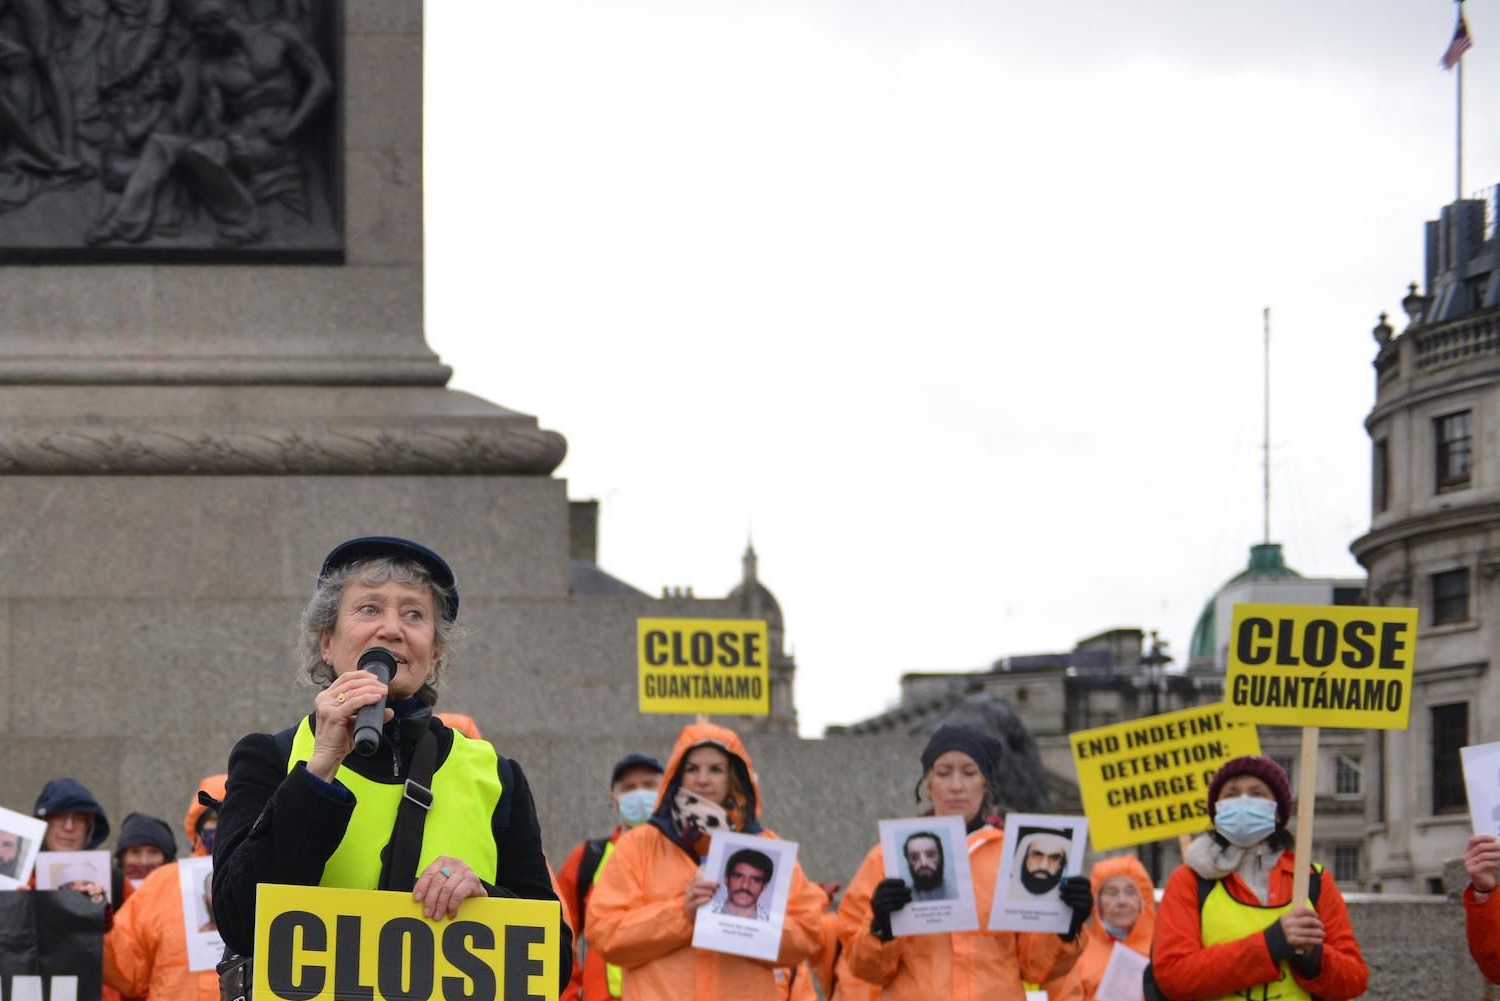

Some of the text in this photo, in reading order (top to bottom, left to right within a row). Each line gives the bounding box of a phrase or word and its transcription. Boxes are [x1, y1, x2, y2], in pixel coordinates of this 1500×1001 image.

[644, 630, 761, 668] CLOSE
[1237, 617, 1408, 669] CLOSE
[644, 669, 762, 700] GUANTÁNAMO
[1233, 671, 1403, 712] GUANTÁNAMO
[1077, 711, 1248, 759] END INDEFINI
[1101, 741, 1230, 781] DETENTION:
[1106, 774, 1197, 808] CHARGE
[1128, 799, 1208, 830] RELEAS
